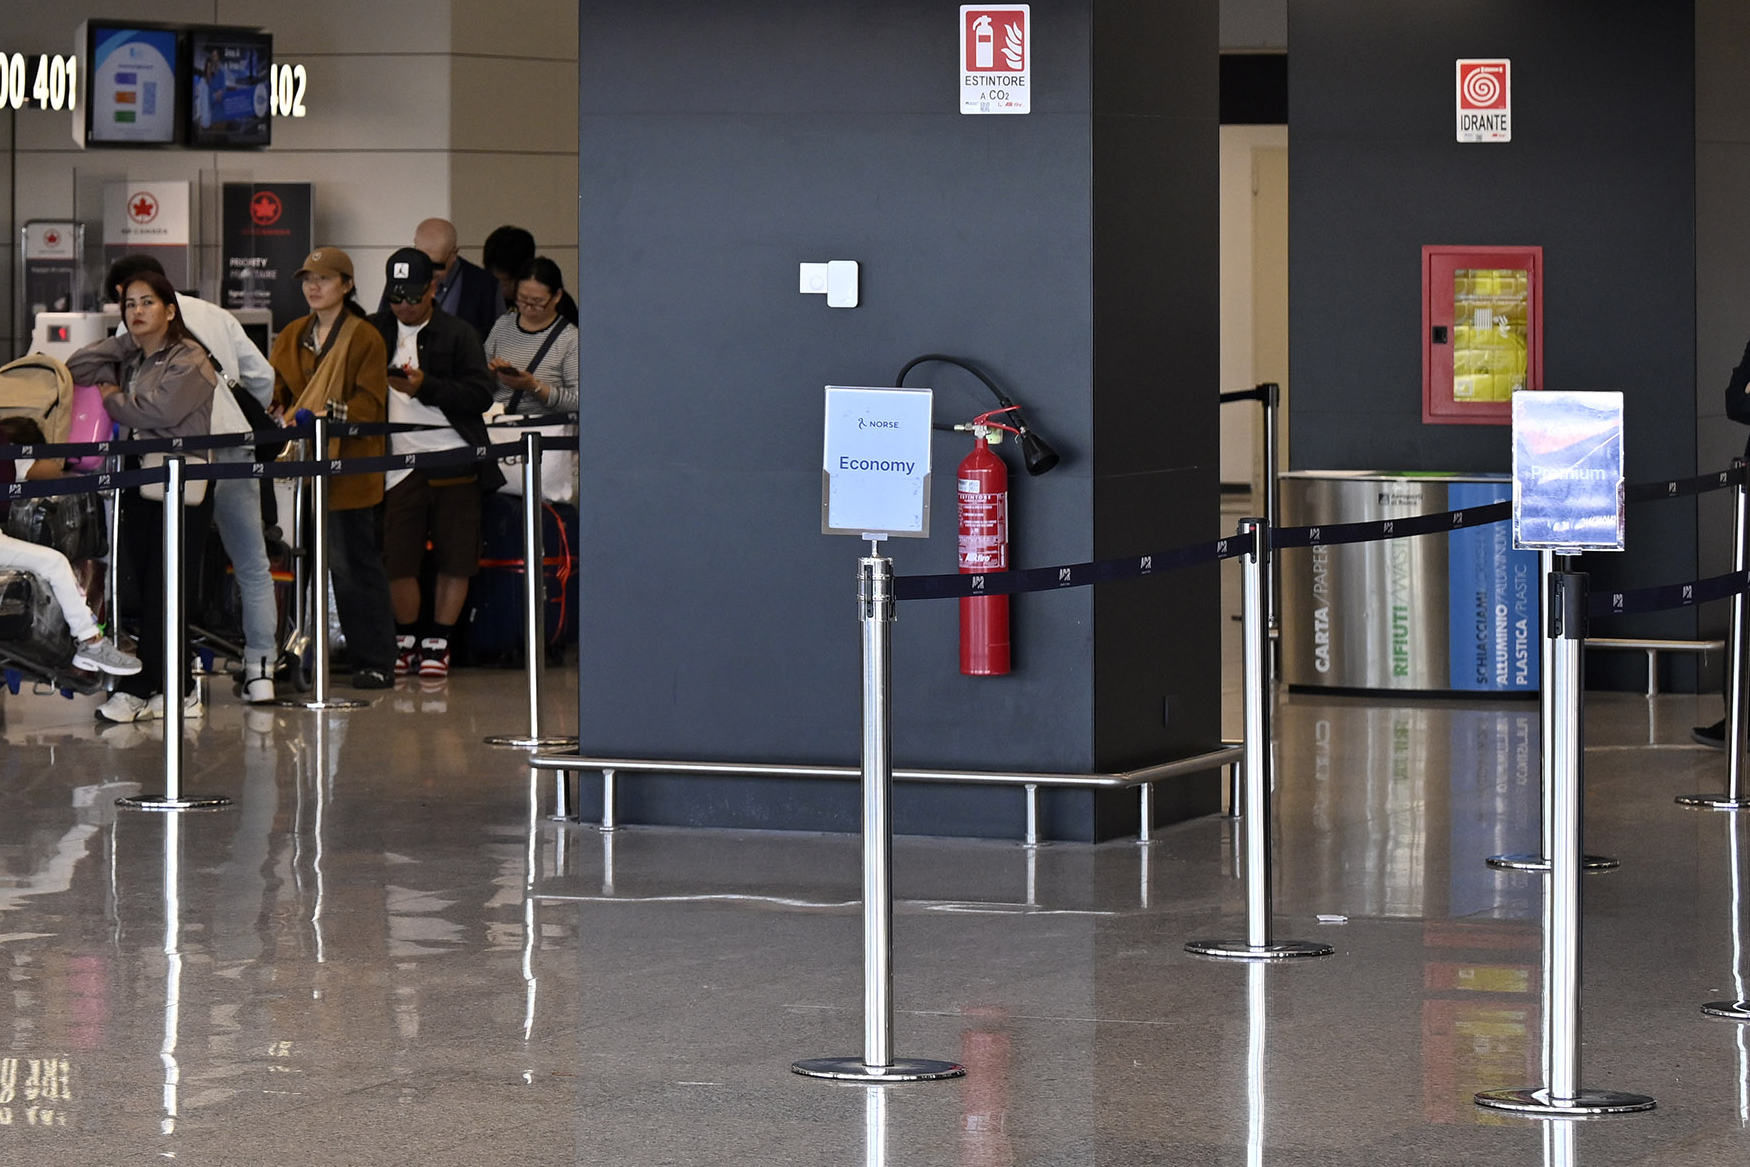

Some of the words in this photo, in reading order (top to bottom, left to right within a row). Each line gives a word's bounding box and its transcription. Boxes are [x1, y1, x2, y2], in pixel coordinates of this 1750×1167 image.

[33, 54, 76, 111] 401
[965, 75, 1025, 87] ESTINTORE
[980, 92, 986, 100] A
[988, 89, 1010, 101] CO2
[1460, 114, 1507, 131] IDRANTE
[869, 420, 899, 429] NORSE
[839, 455, 916, 476] Economy
